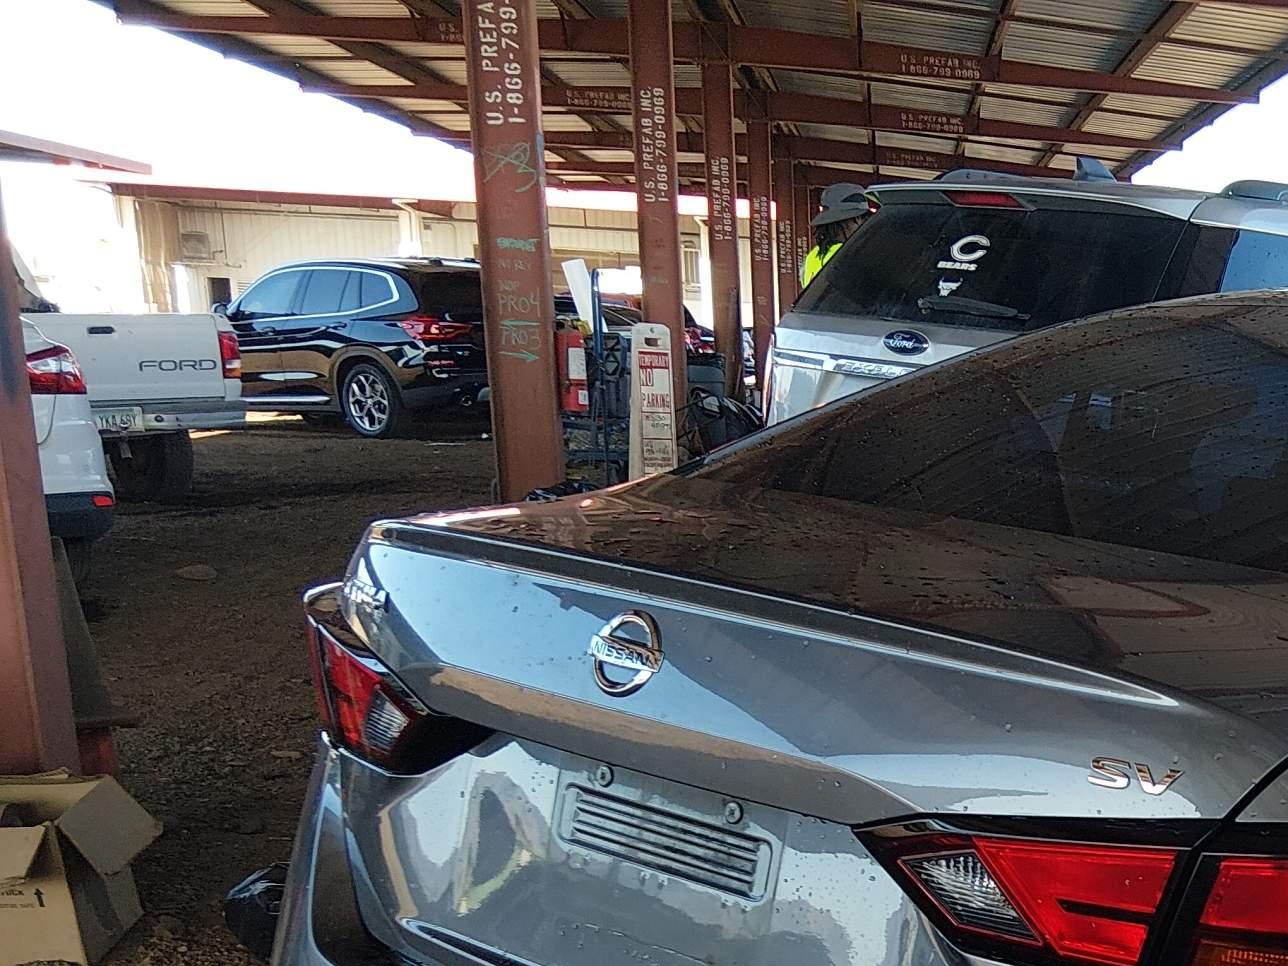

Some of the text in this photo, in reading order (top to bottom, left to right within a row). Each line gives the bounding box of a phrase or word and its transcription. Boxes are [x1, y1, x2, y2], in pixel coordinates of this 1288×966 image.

[485, 85, 505, 126] U.S.
[640, 86, 657, 203] U.S. PREFAB INC.
[936, 260, 978, 271] BEARS
[138, 359, 217, 372] FORD
[639, 354, 669, 367] TEMPORARY
[640, 368, 653, 386] NO
[641, 392, 671, 408] PARKING
[594, 641, 657, 669] NISSAN
[1087, 756, 1186, 796] SV
